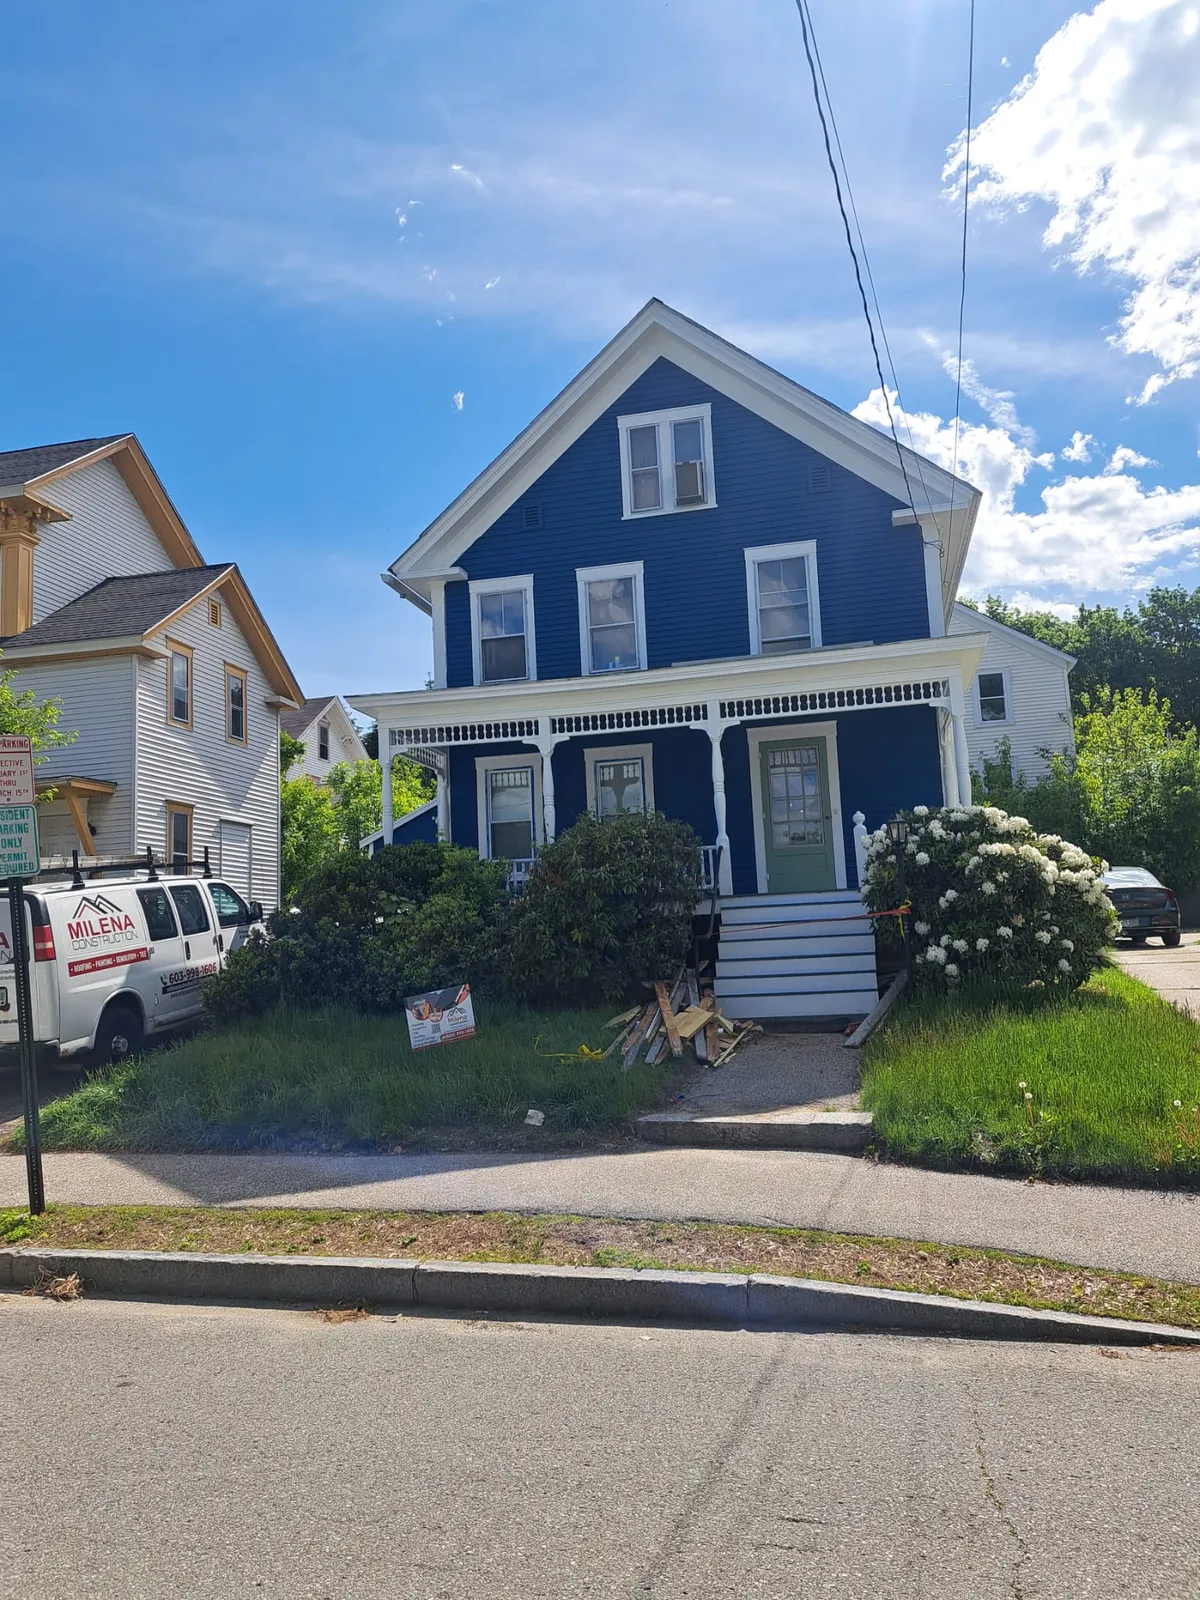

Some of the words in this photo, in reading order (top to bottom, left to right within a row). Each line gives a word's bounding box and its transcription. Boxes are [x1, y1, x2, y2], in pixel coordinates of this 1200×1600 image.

[1, 836, 23, 849] ONLY
[67, 914, 135, 940] MILENA
[72, 930, 138, 951] CONSTRUCTION
